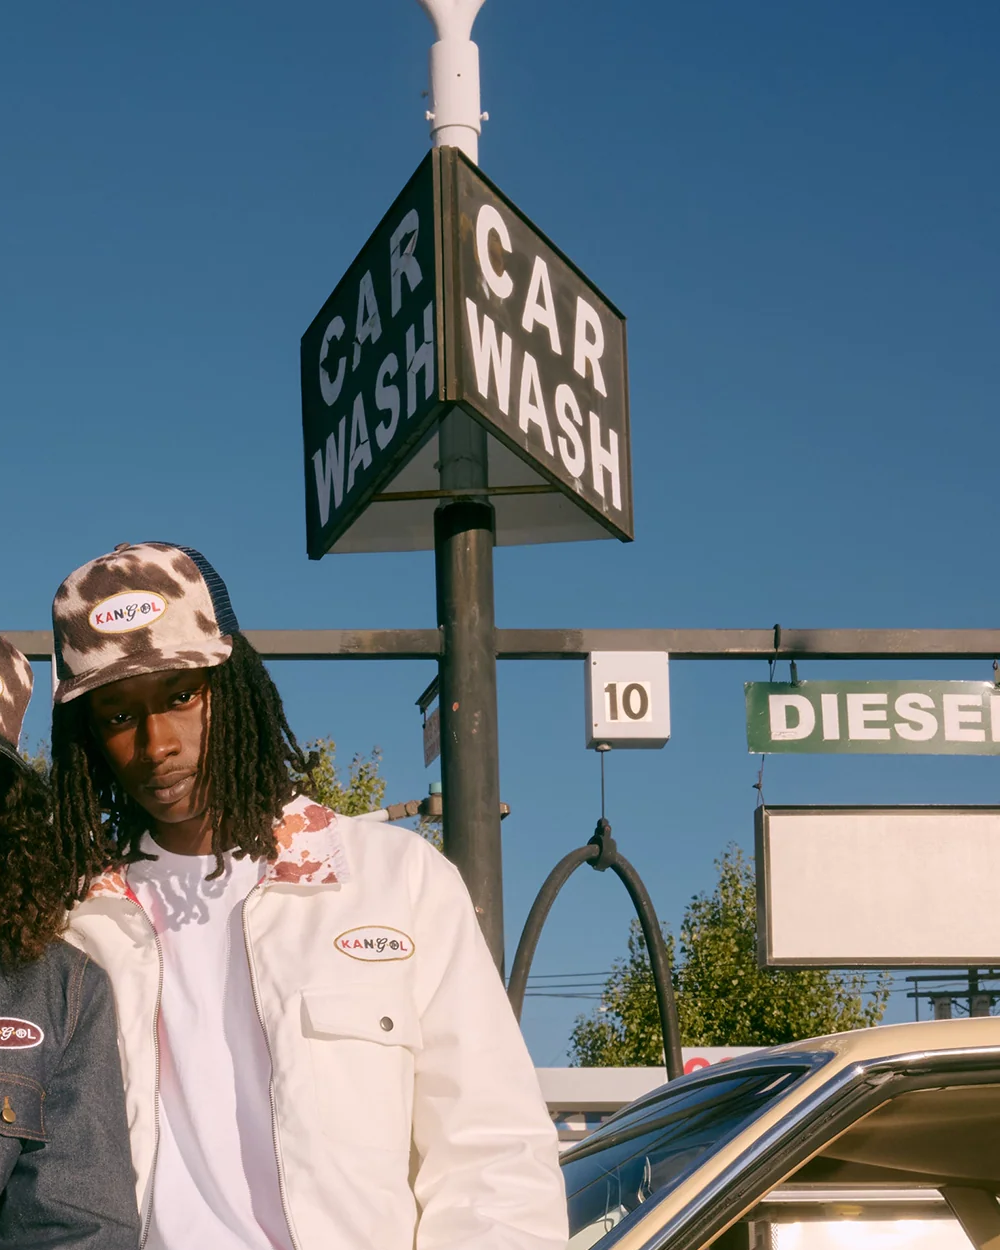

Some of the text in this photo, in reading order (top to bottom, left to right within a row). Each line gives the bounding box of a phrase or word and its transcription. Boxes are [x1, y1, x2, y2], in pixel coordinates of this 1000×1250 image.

[318, 208, 424, 407] CAR
[474, 203, 608, 398] CAR
[311, 300, 435, 529] WASH
[465, 296, 623, 512] WASH
[95, 601, 161, 625] KANGOL
[604, 682, 649, 721] 10
[768, 692, 1000, 743] DIESE
[341, 937, 408, 953] KANGOL
